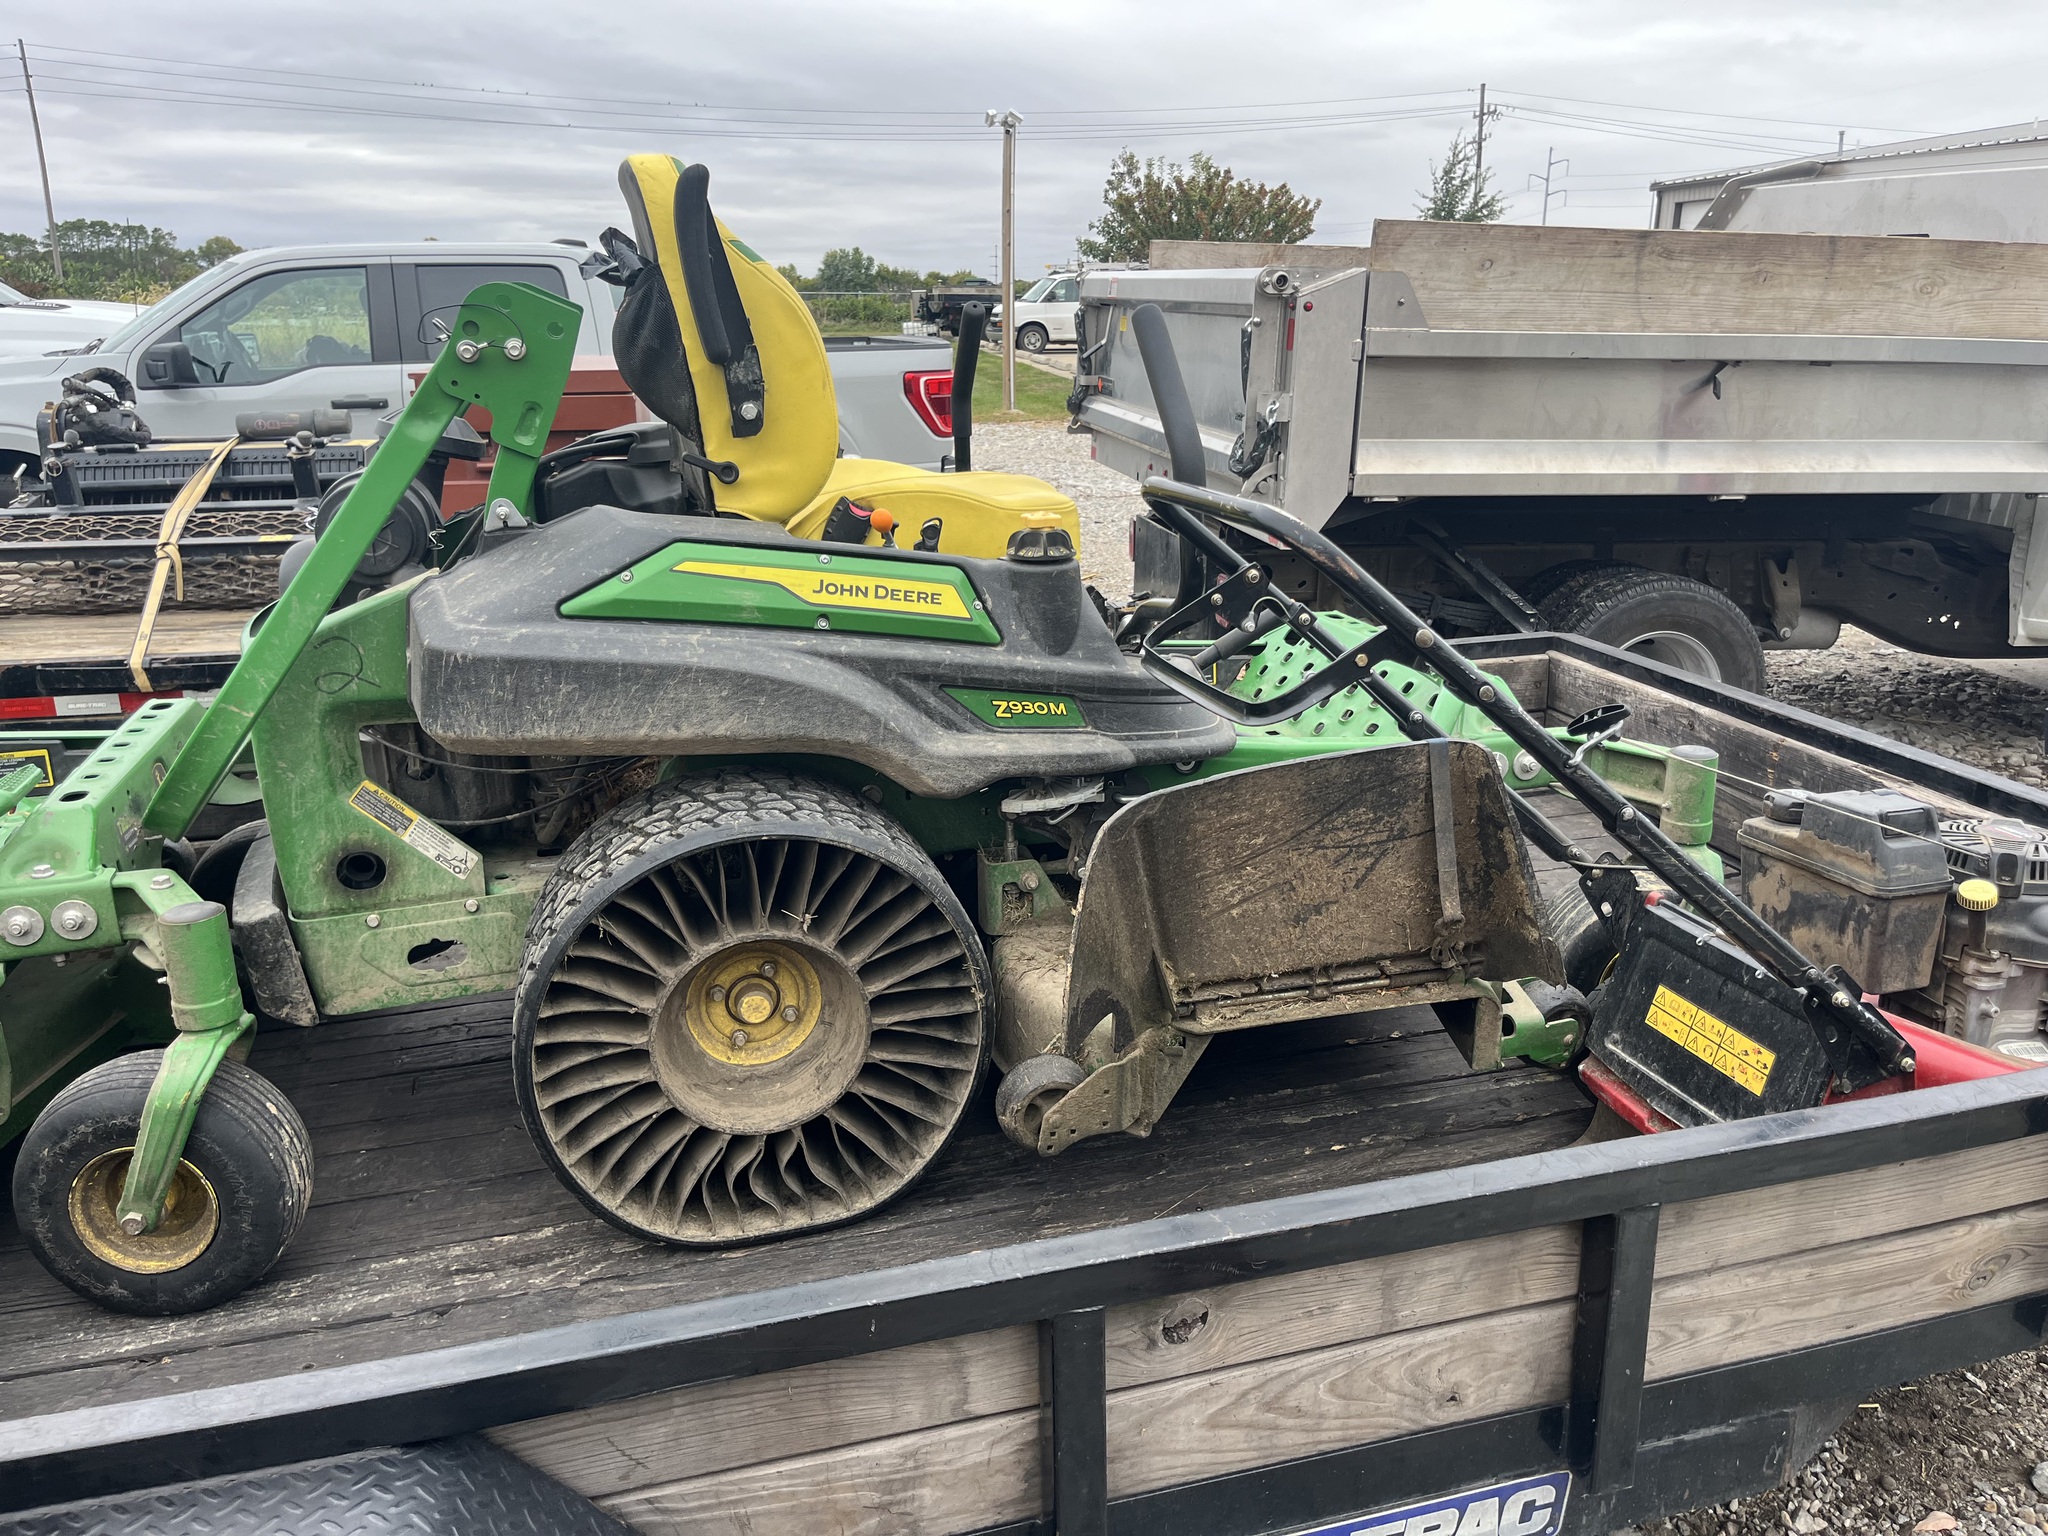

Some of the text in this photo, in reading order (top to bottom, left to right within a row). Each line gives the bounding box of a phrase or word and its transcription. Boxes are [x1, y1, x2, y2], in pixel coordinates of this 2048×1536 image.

[812, 579, 942, 605] JOHN DEERE
[991, 699, 1068, 718] Z930M
[379, 792, 406, 813] CAUTION
[1349, 1485, 1556, 1536] RAC
